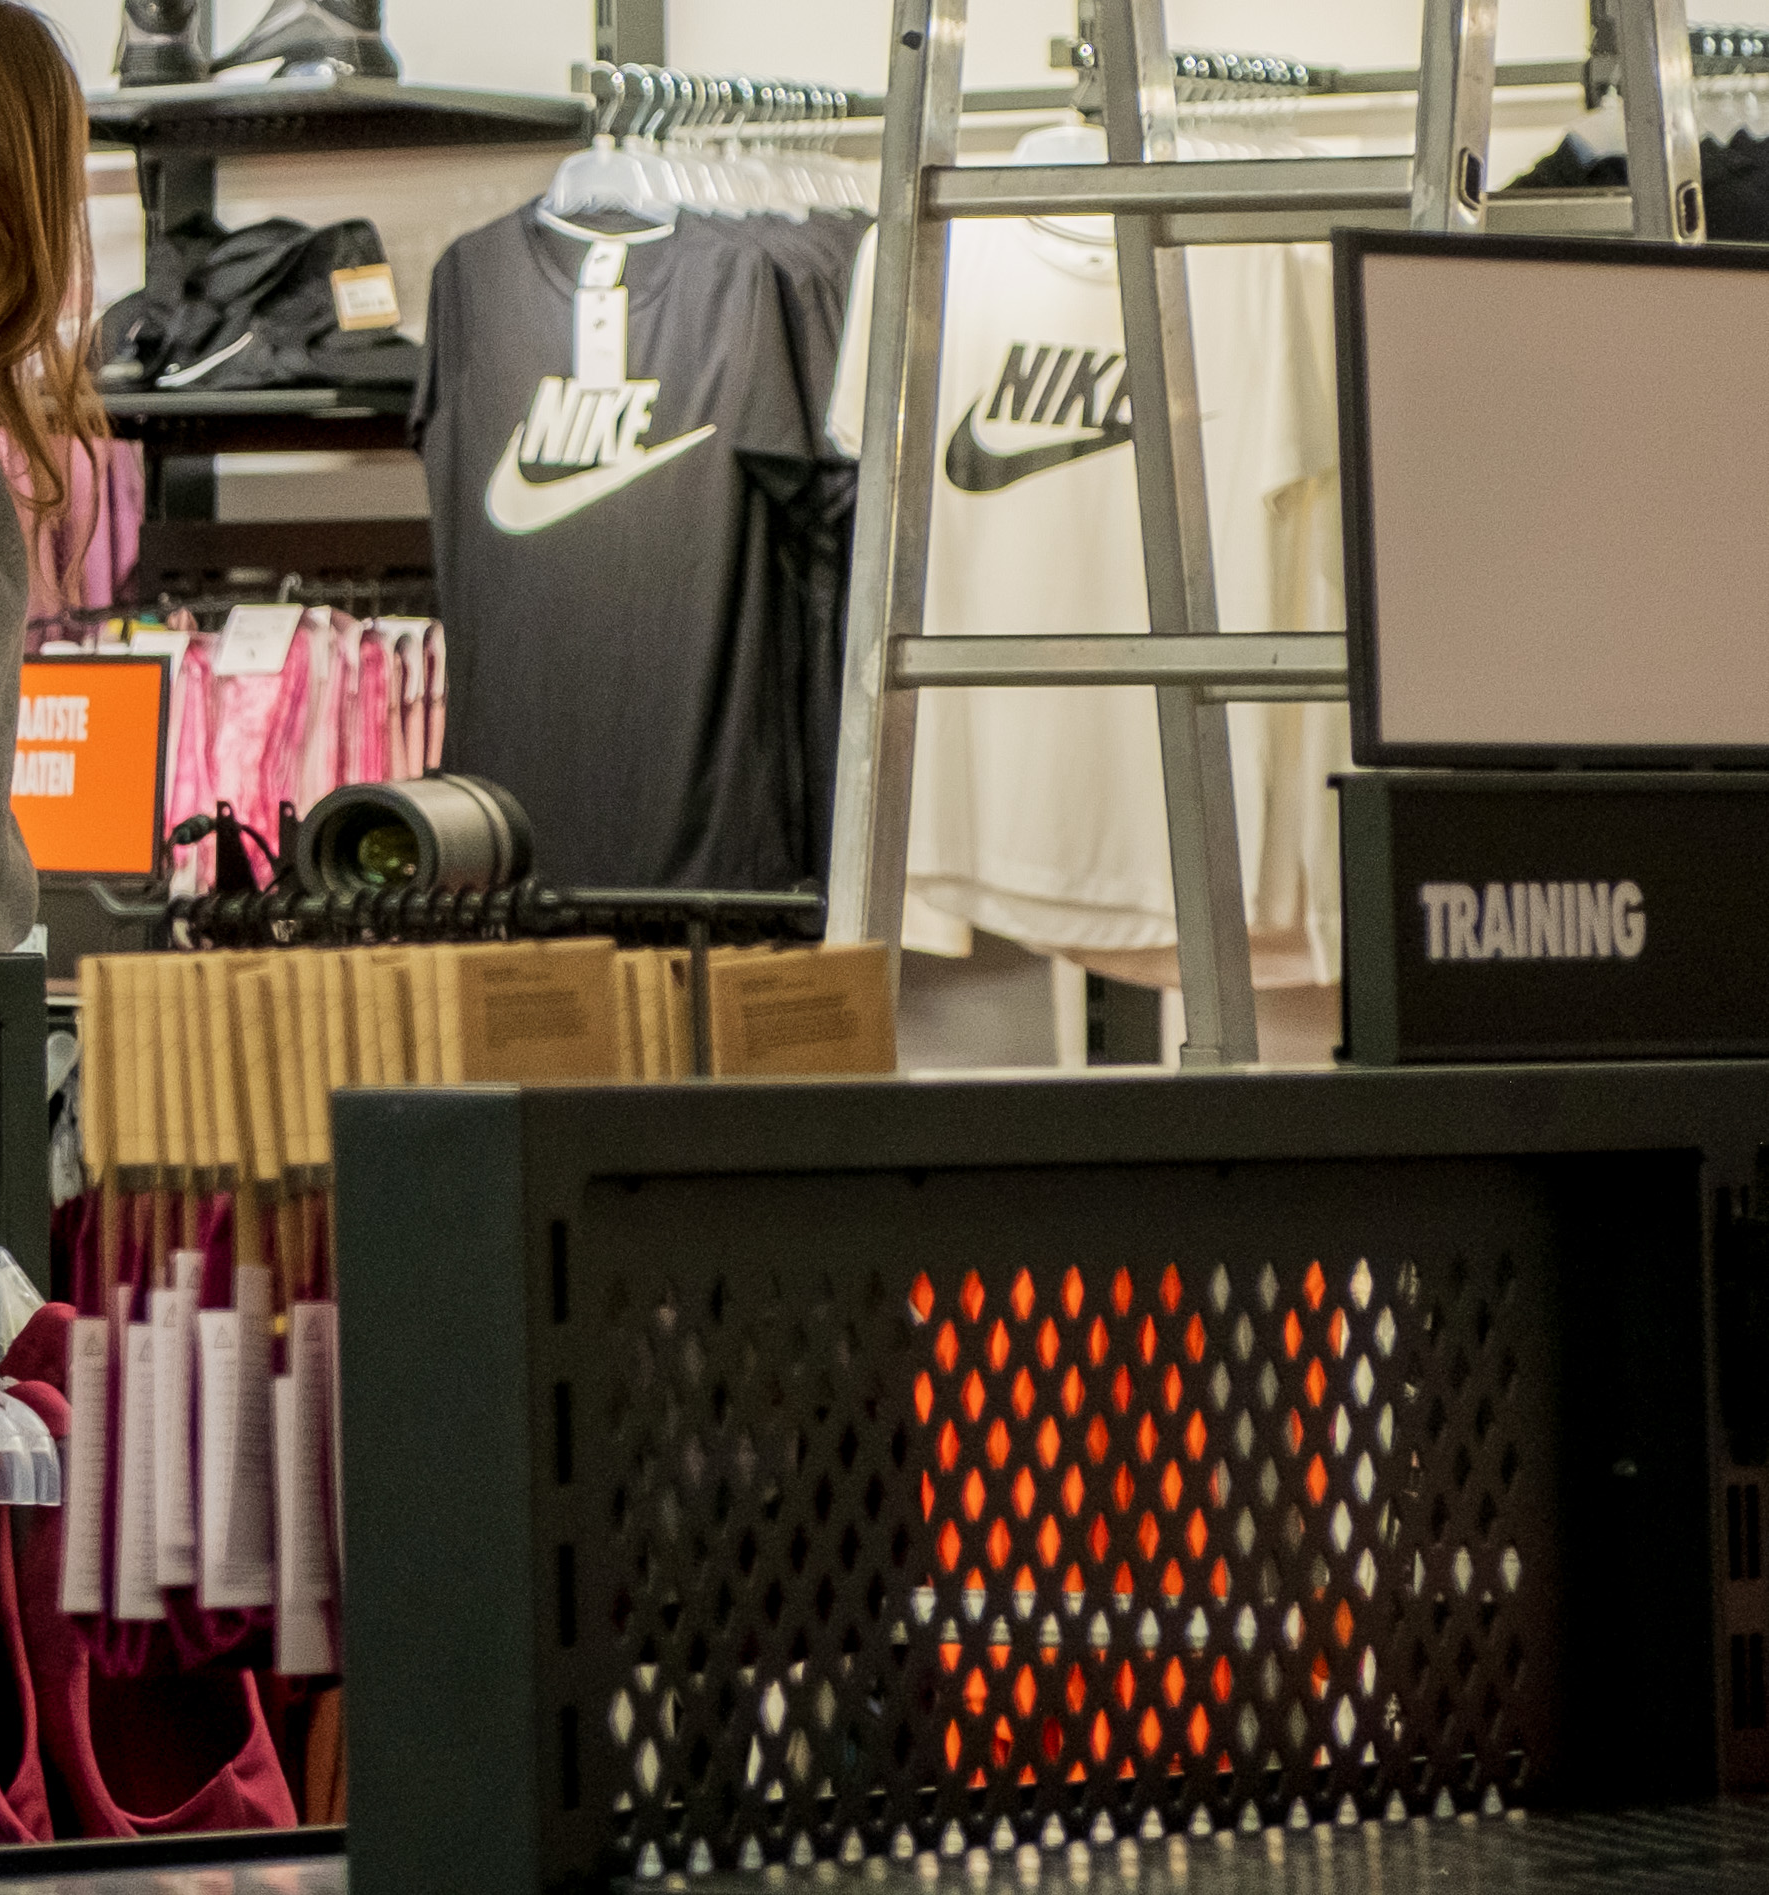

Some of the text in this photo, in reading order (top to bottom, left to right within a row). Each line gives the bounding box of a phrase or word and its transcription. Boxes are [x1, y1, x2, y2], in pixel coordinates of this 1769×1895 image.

[519, 377, 660, 465] NIKE
[17, 694, 89, 740] AATSTE
[1419, 880, 1646, 961] TRAINING
